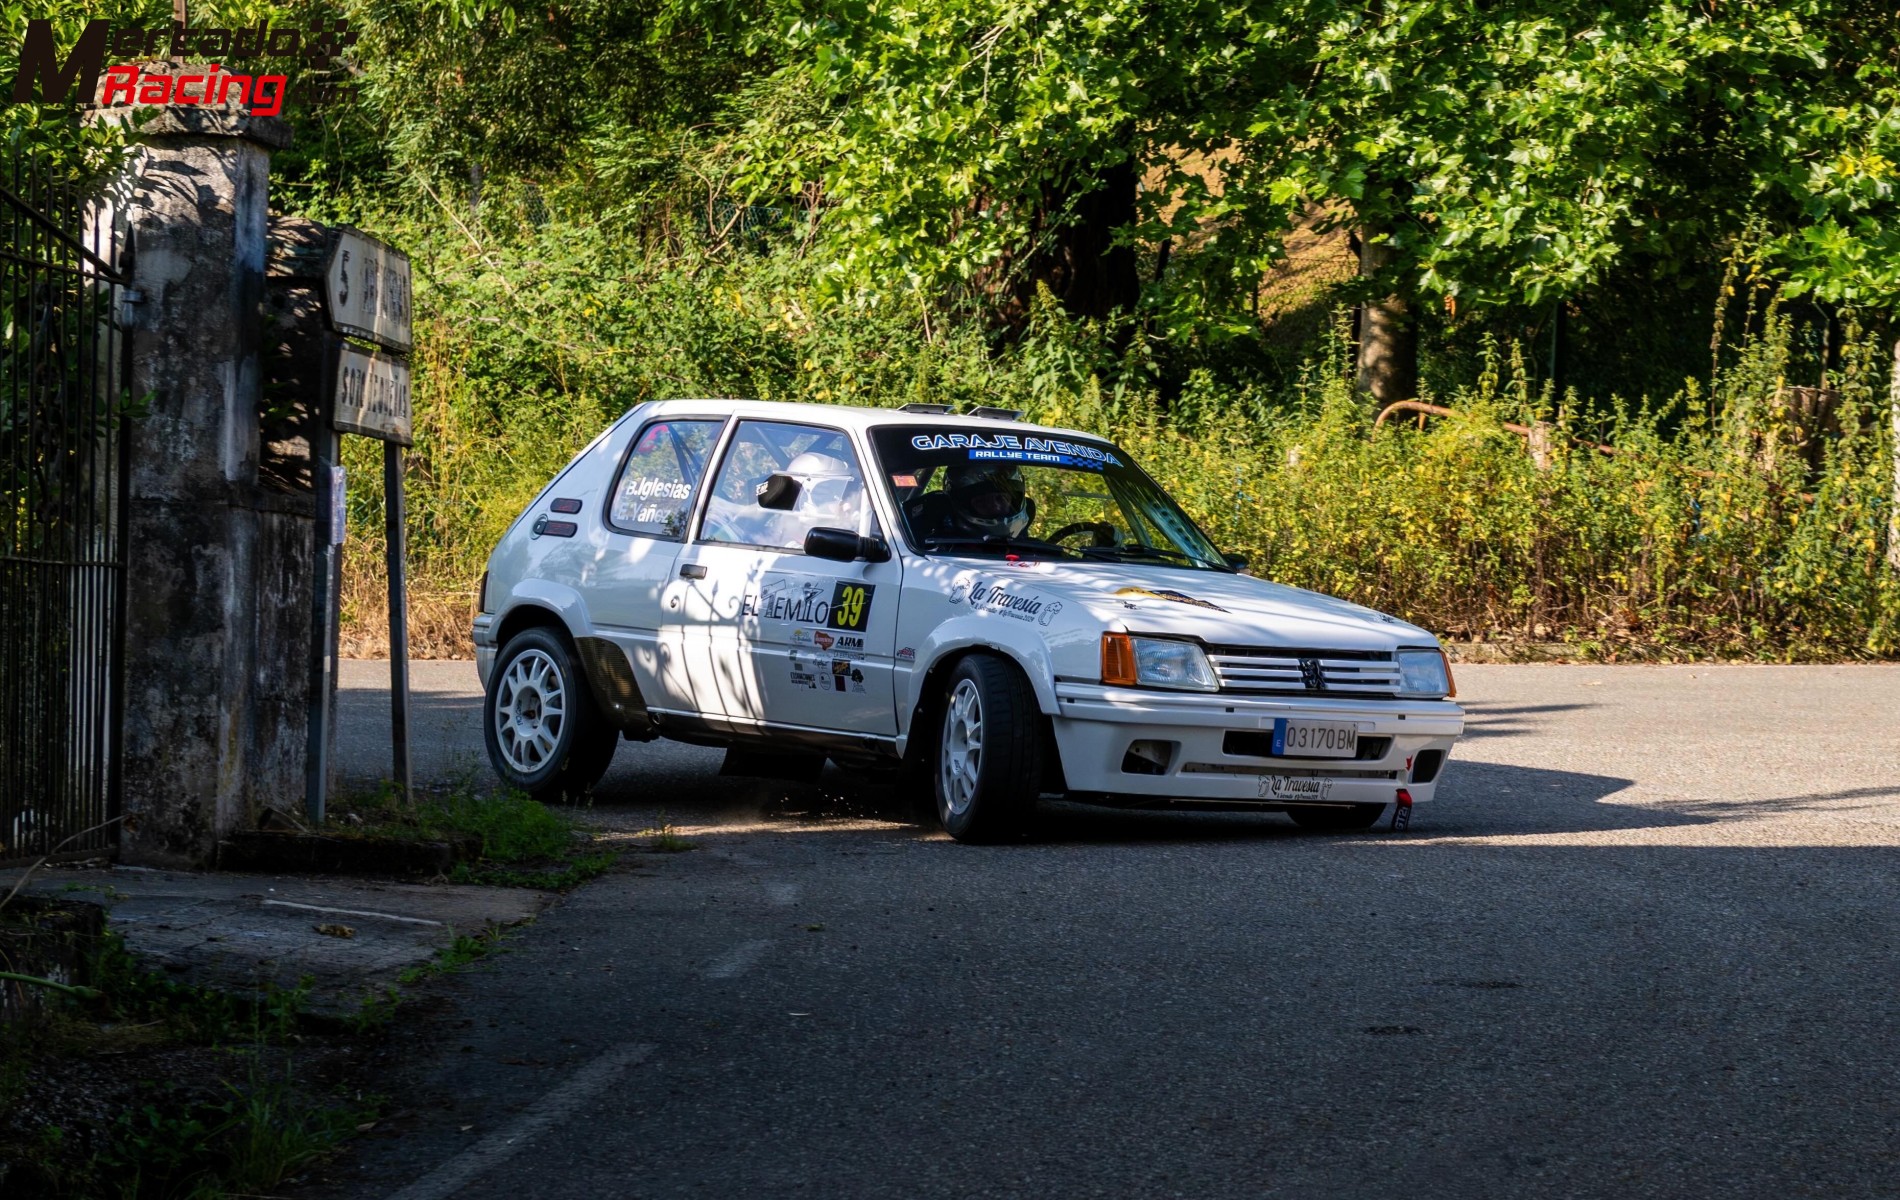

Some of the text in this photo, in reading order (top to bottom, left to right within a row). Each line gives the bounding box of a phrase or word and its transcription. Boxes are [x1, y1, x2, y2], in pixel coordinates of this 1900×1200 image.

[911, 434, 1124, 467] GARAJE AVENIDA
[975, 450, 1060, 462] RALLYE TEAM
[626, 477, 691, 500] B.Iglesias
[742, 595, 759, 616] EL
[837, 586, 864, 627] 39
[968, 581, 1042, 615] La Travesía
[1271, 775, 1281, 795] La
